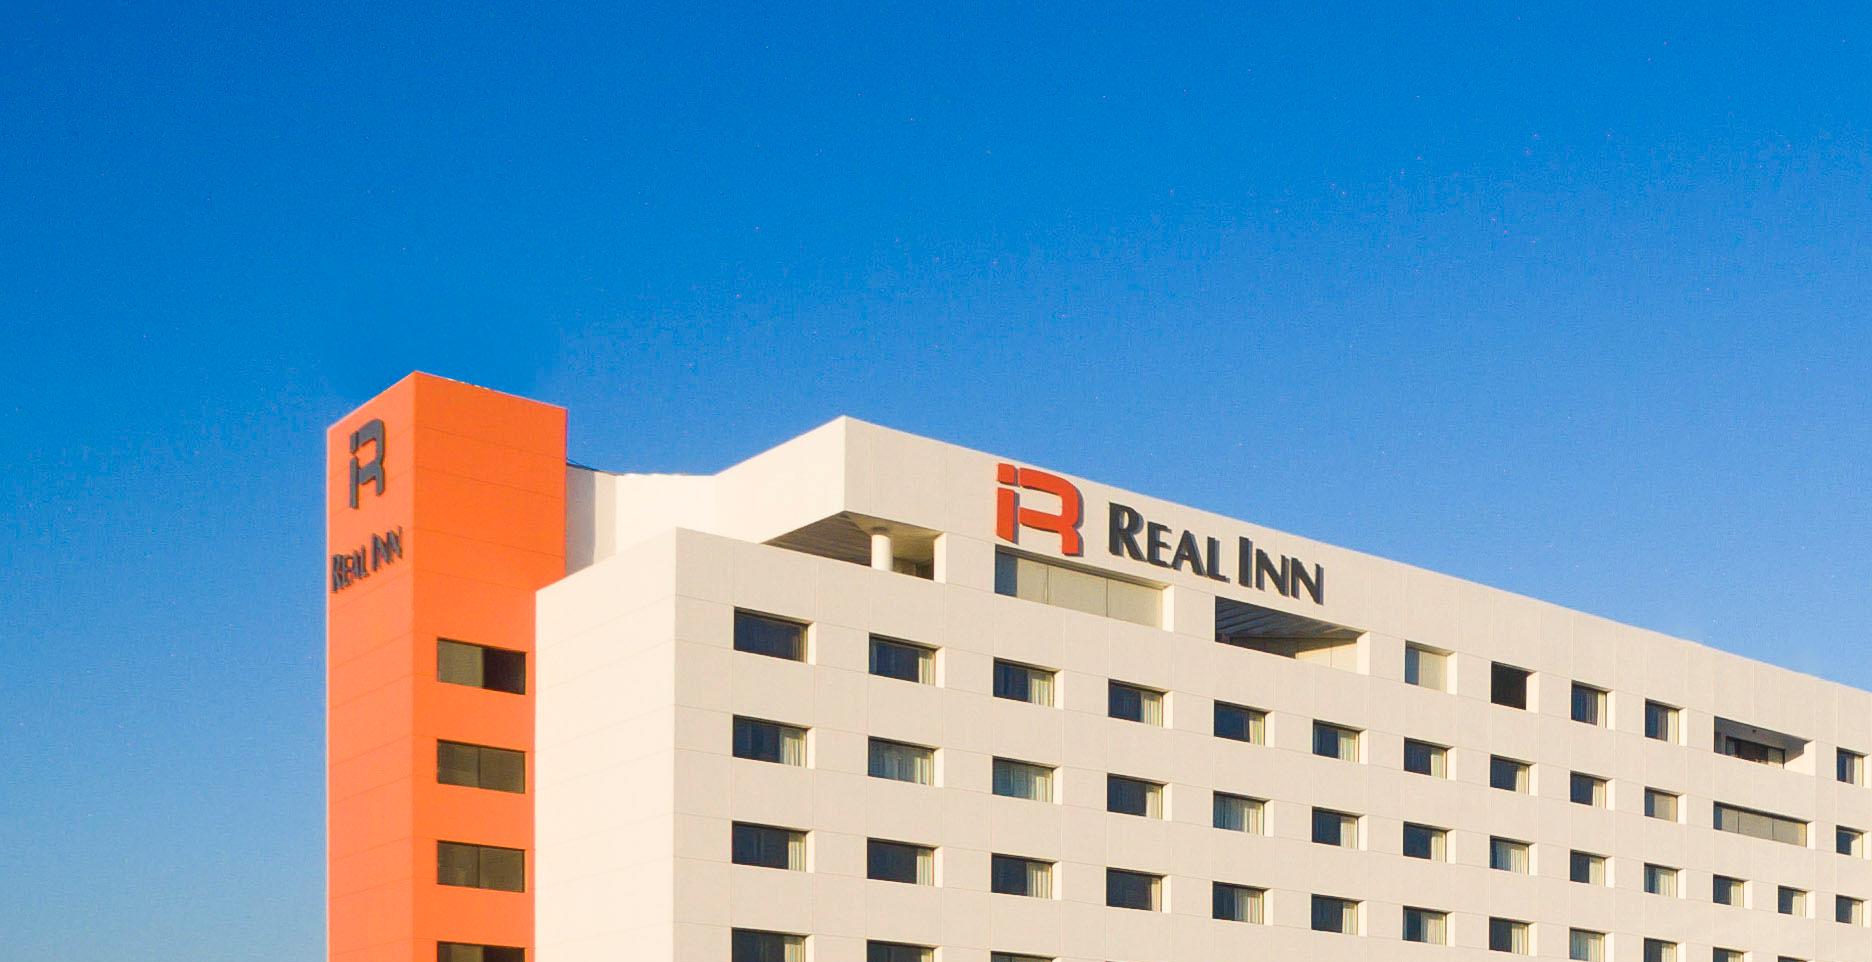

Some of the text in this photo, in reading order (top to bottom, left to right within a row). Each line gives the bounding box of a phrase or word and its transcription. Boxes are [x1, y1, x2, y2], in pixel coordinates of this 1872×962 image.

[331, 525, 403, 594] REAL INN
[1108, 501, 1325, 606] REAL INN
